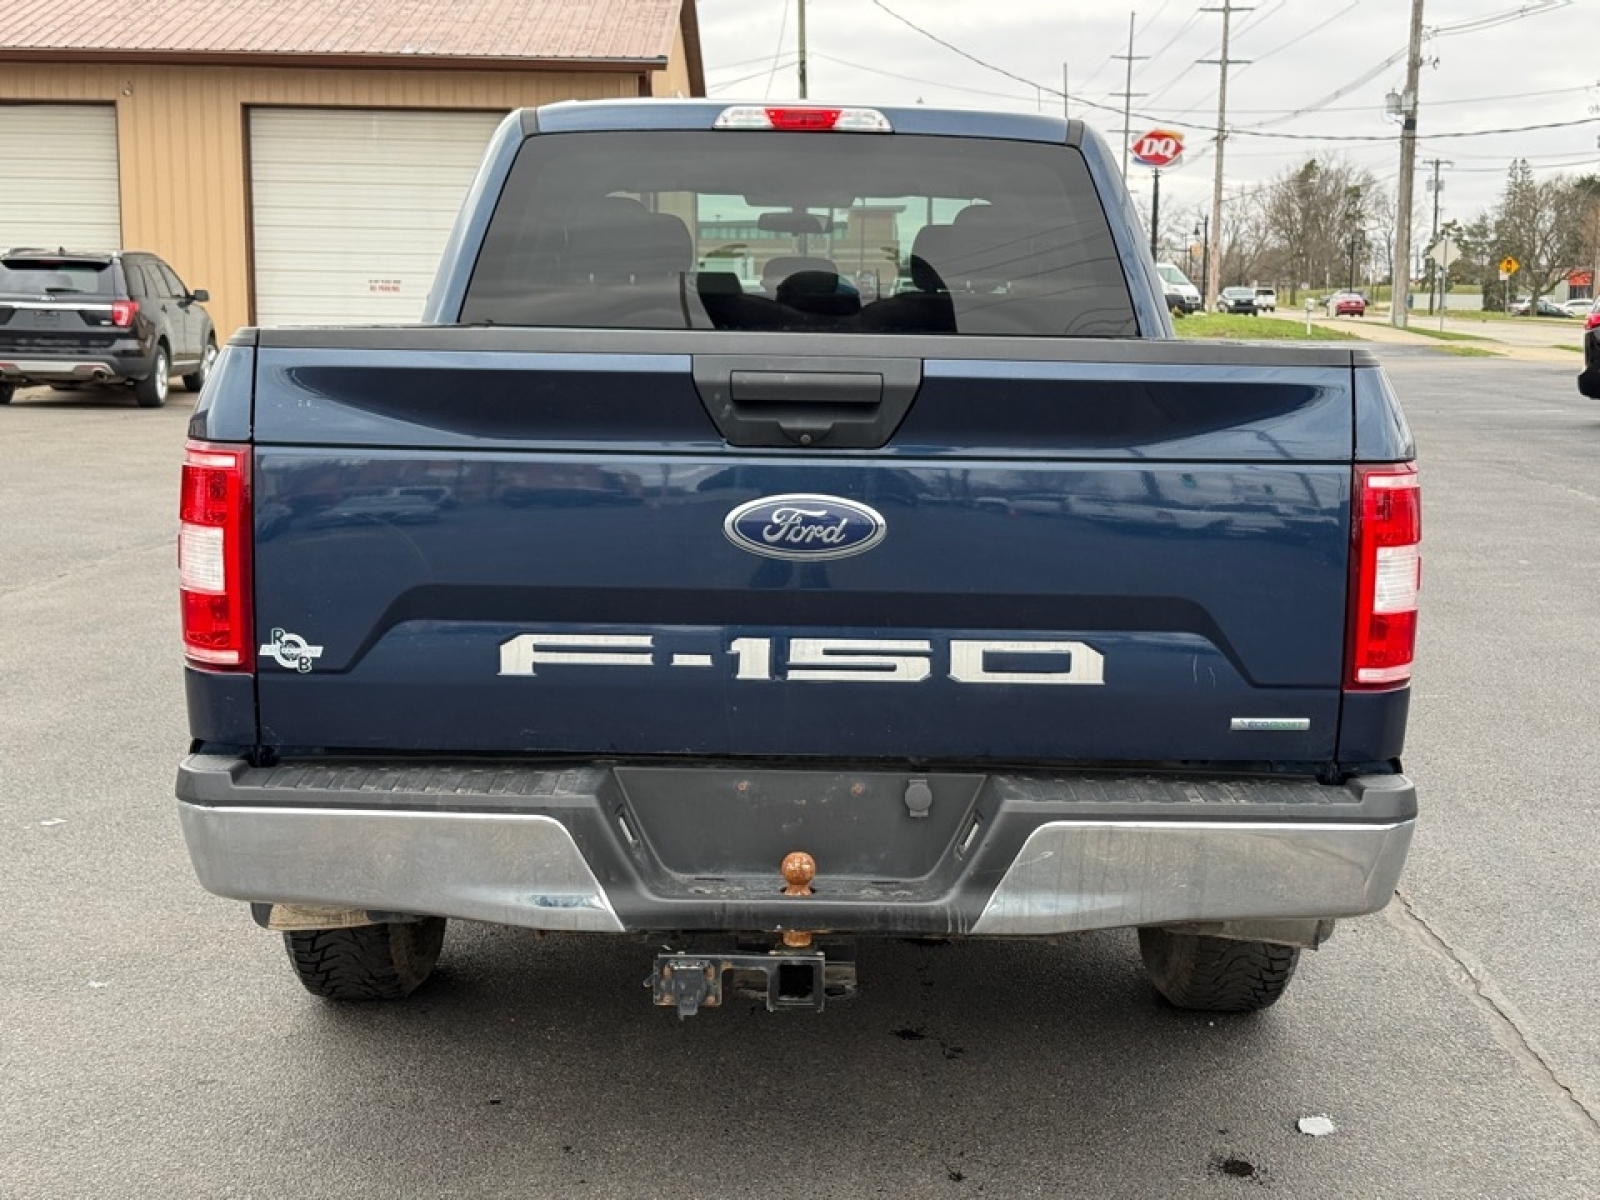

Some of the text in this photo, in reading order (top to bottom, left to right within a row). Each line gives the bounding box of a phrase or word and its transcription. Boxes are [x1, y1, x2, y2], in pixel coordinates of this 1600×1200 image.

[1140, 137, 1176, 159] DQ
[762, 507, 848, 544] Ford
[497, 634, 1105, 685] F-150
